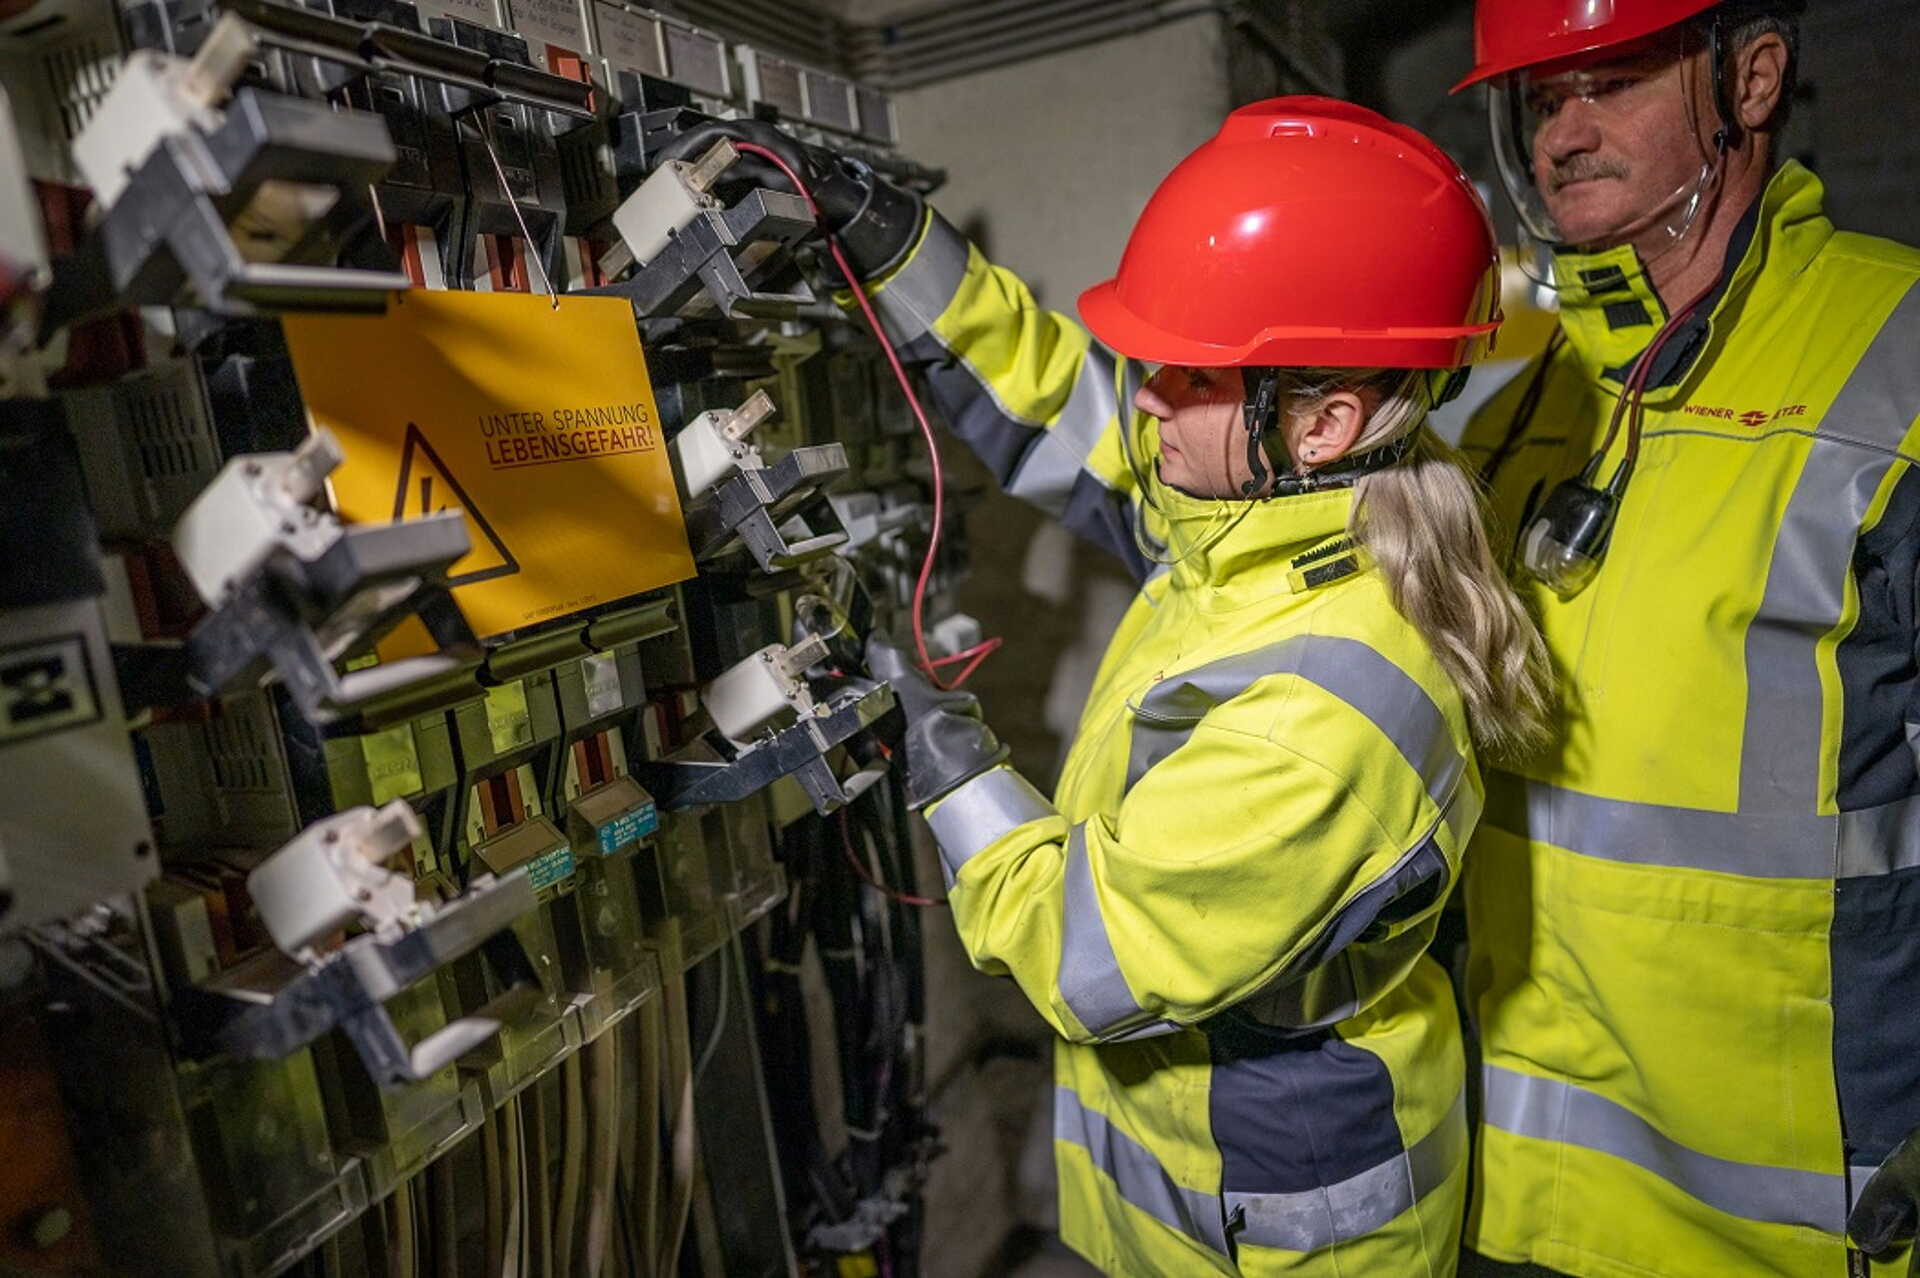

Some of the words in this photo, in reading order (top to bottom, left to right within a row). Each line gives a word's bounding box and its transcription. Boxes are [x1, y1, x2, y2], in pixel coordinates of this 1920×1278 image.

[479, 412, 546, 438] UNTER
[553, 403, 649, 430] SPANNUNG
[1683, 404, 1734, 420] WIENER
[485, 425, 655, 465] LEBENSGEFAHR!
